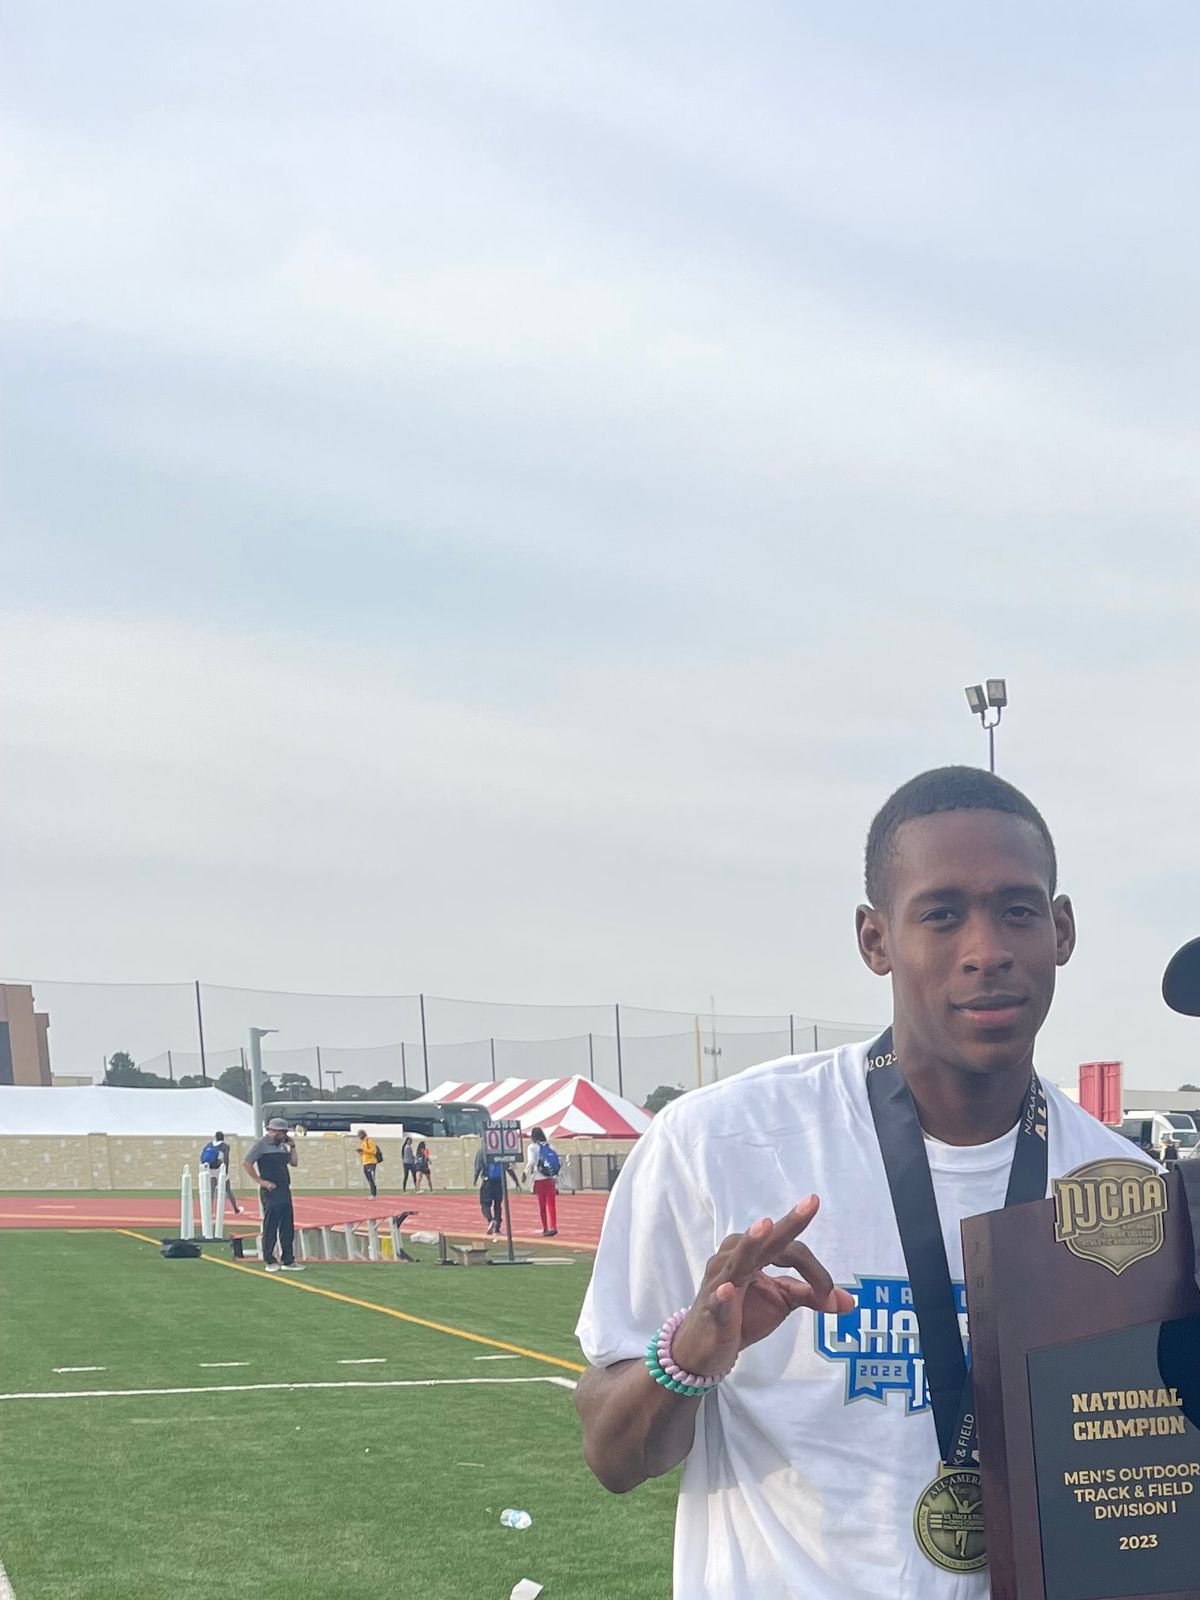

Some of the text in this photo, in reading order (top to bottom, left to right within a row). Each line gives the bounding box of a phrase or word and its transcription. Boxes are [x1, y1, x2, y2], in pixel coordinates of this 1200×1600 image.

[1058, 1180, 1162, 1235] NJCAA
[860, 1365, 902, 1377] 2022
[1071, 1387, 1183, 1413] NATIONAL
[958, 1413, 974, 1447] FIELD
[1073, 1415, 1186, 1441] CHAMPION
[929, 1474, 982, 1498] ALL-AMERI
[1064, 1463, 1200, 1486] MEN'S OUTDOOR
[1074, 1482, 1194, 1503] TRACK & FIELD
[1095, 1500, 1177, 1520] DIVISION I
[1119, 1534, 1158, 1550] 2023
